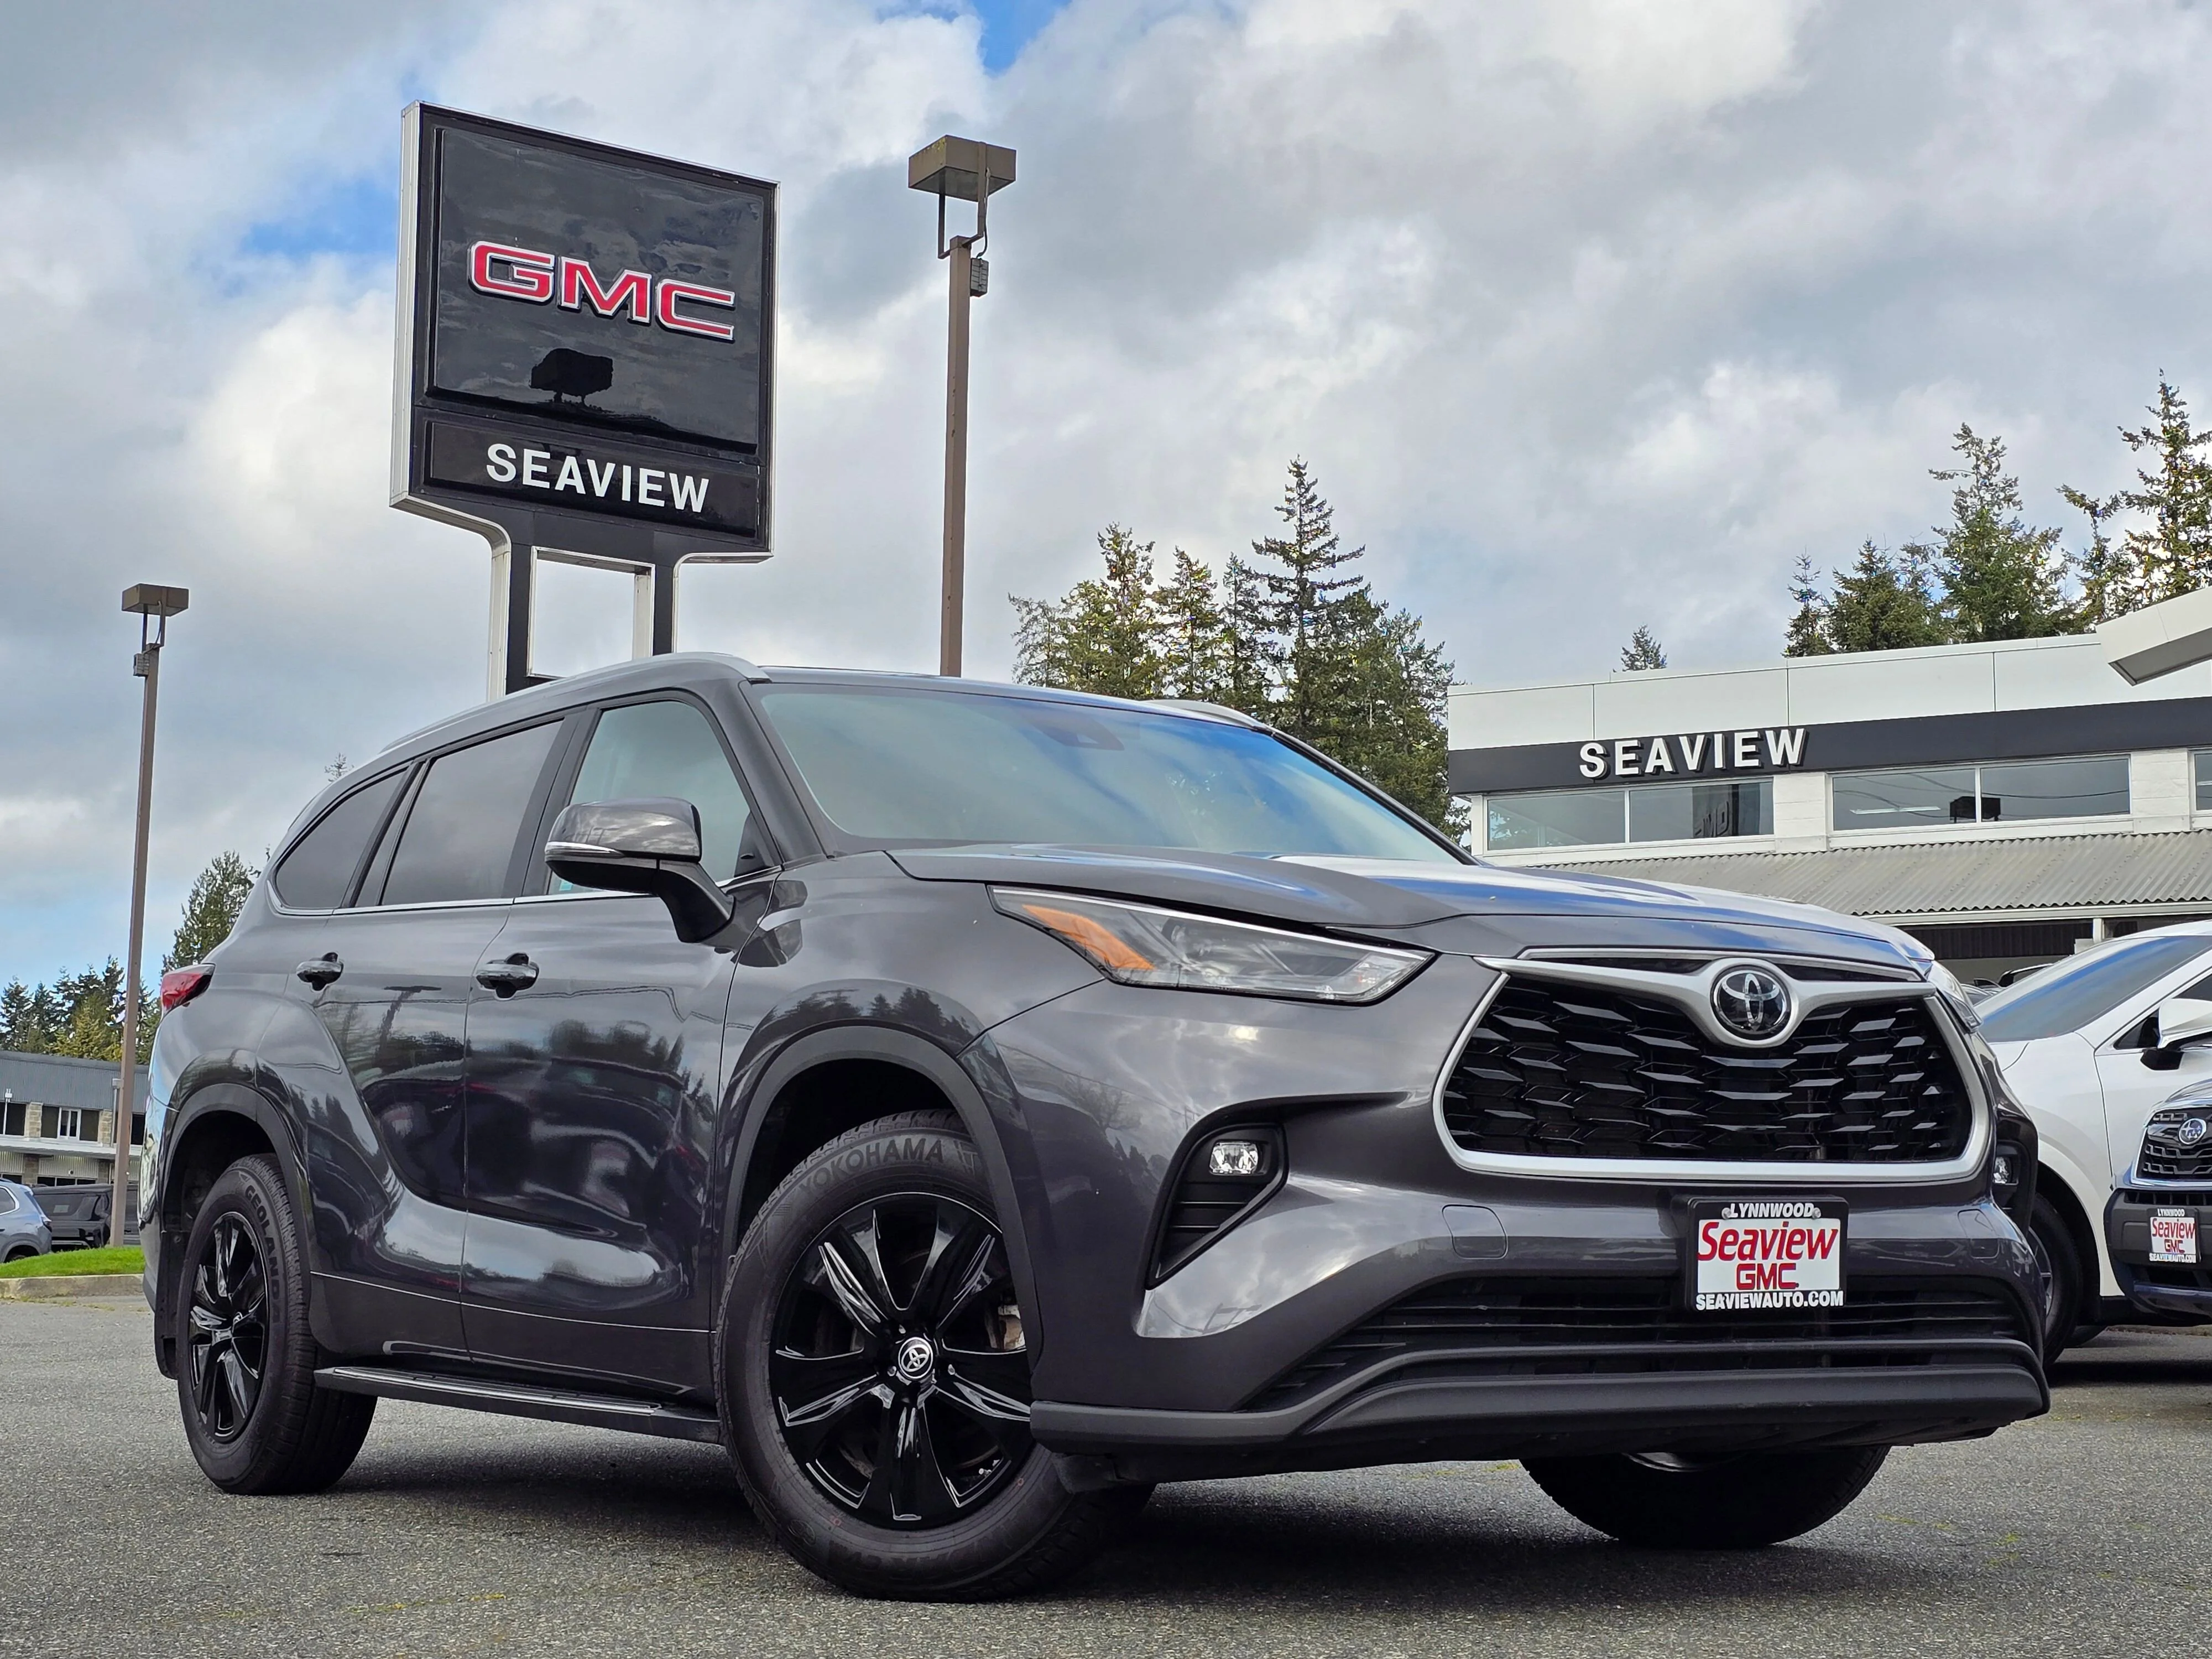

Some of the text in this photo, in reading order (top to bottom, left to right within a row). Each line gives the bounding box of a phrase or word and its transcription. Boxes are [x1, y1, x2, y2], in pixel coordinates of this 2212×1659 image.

[468, 241, 735, 341] GMC
[486, 443, 709, 513] SEAVIEW
[1579, 728, 1808, 778] SEAVIEW
[800, 1138, 944, 1193] YOKOHAMA
[1729, 1203, 1814, 1218] LYNNWOOD
[2152, 1218, 2197, 1239] Seaview
[1696, 1221, 1839, 1261] Seaview
[2164, 1239, 2185, 1253] GMC
[1695, 1290, 1844, 1311] SEAVIEWAUTO.COM
